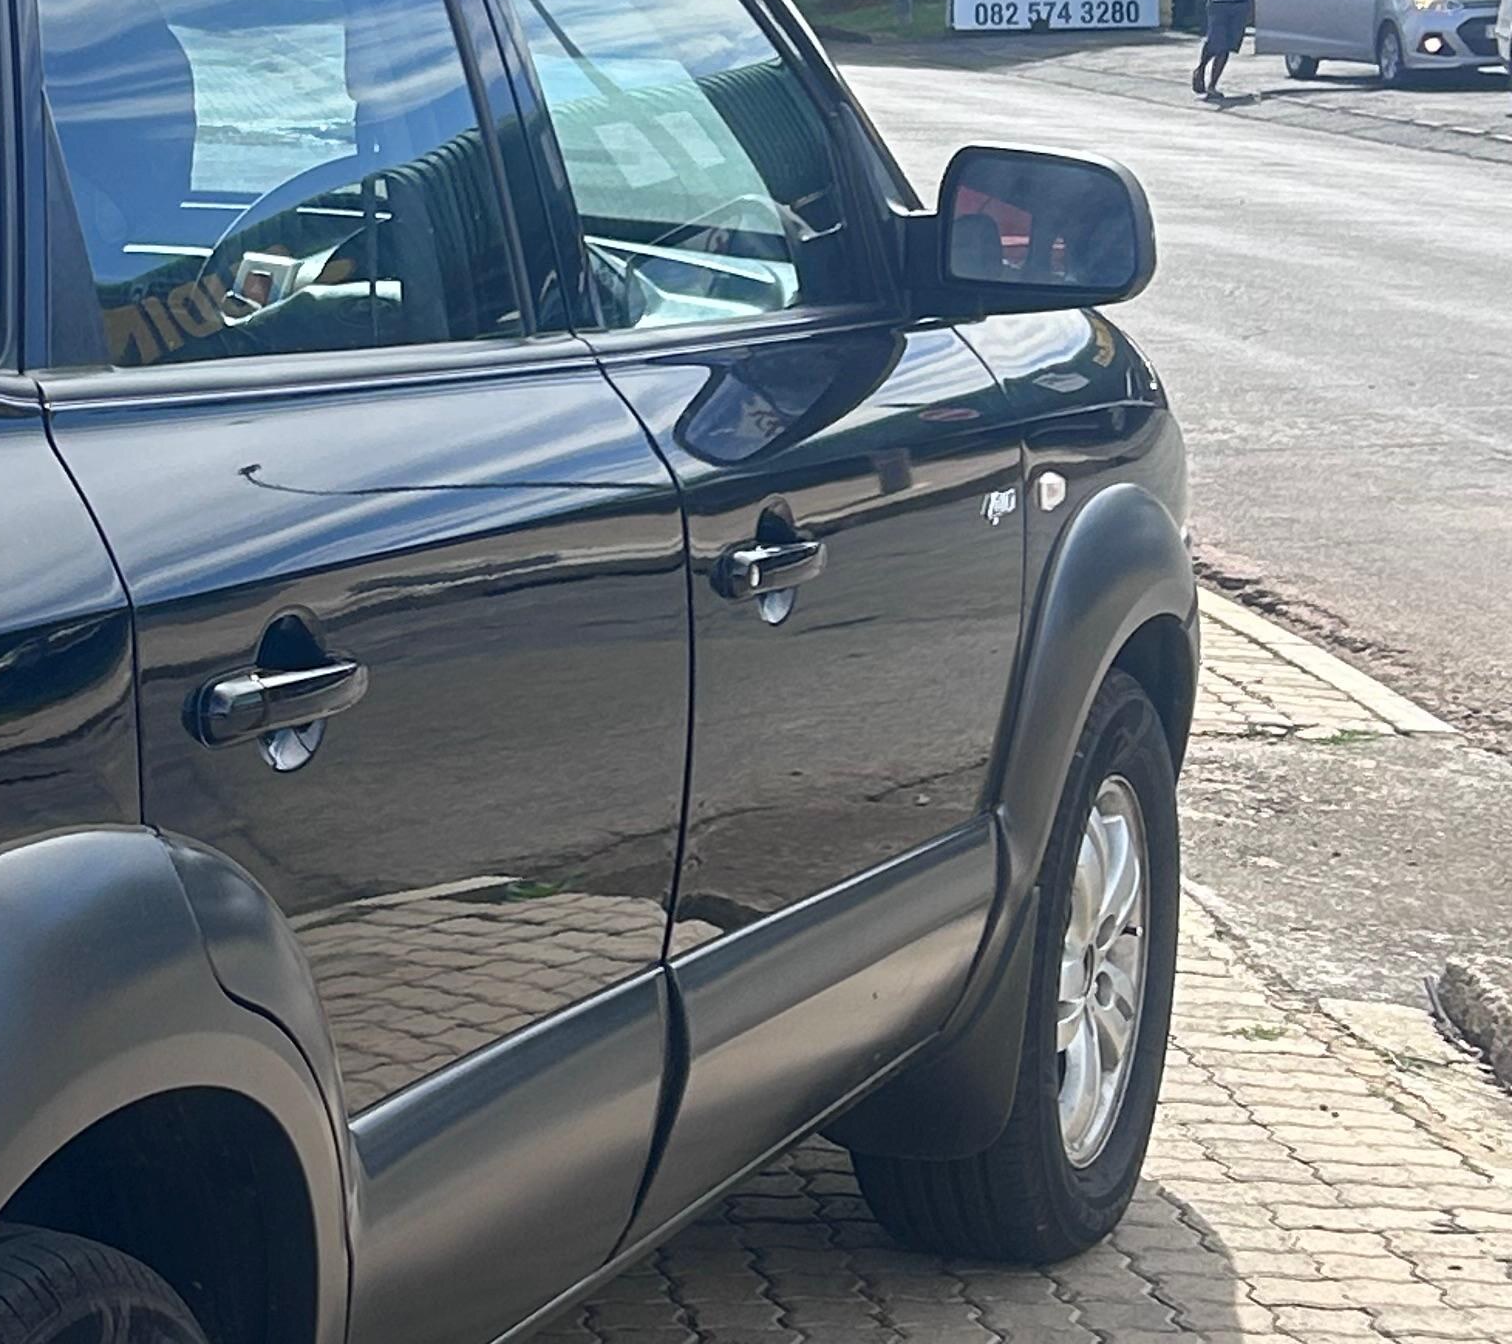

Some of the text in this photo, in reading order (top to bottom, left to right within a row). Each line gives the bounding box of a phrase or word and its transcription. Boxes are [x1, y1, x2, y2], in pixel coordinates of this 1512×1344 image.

[974, 0, 1140, 26] 082 574 3280
